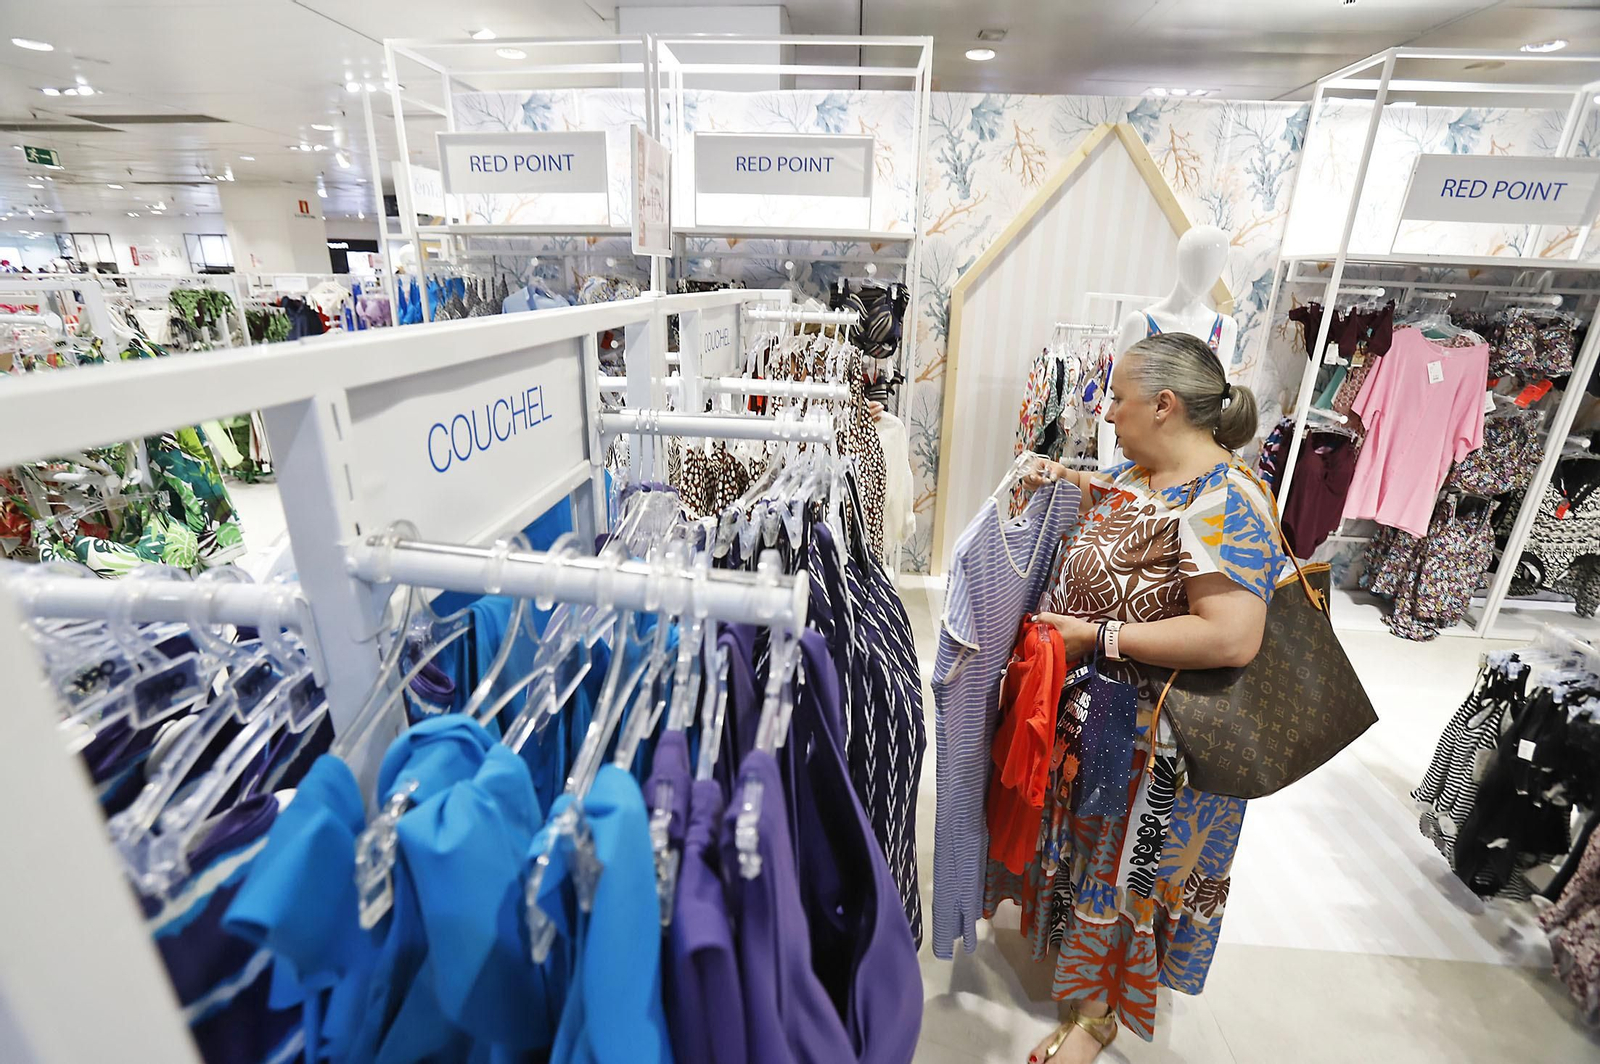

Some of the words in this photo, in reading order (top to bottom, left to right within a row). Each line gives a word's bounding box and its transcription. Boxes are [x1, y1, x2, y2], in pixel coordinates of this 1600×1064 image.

[469, 154, 508, 173] RED
[513, 153, 575, 173] POINT
[736, 155, 772, 172] RED
[777, 156, 835, 173] POINT
[1440, 178, 1488, 198] RED
[1491, 180, 1569, 202] POINT
[427, 384, 553, 474] COUCHEL
